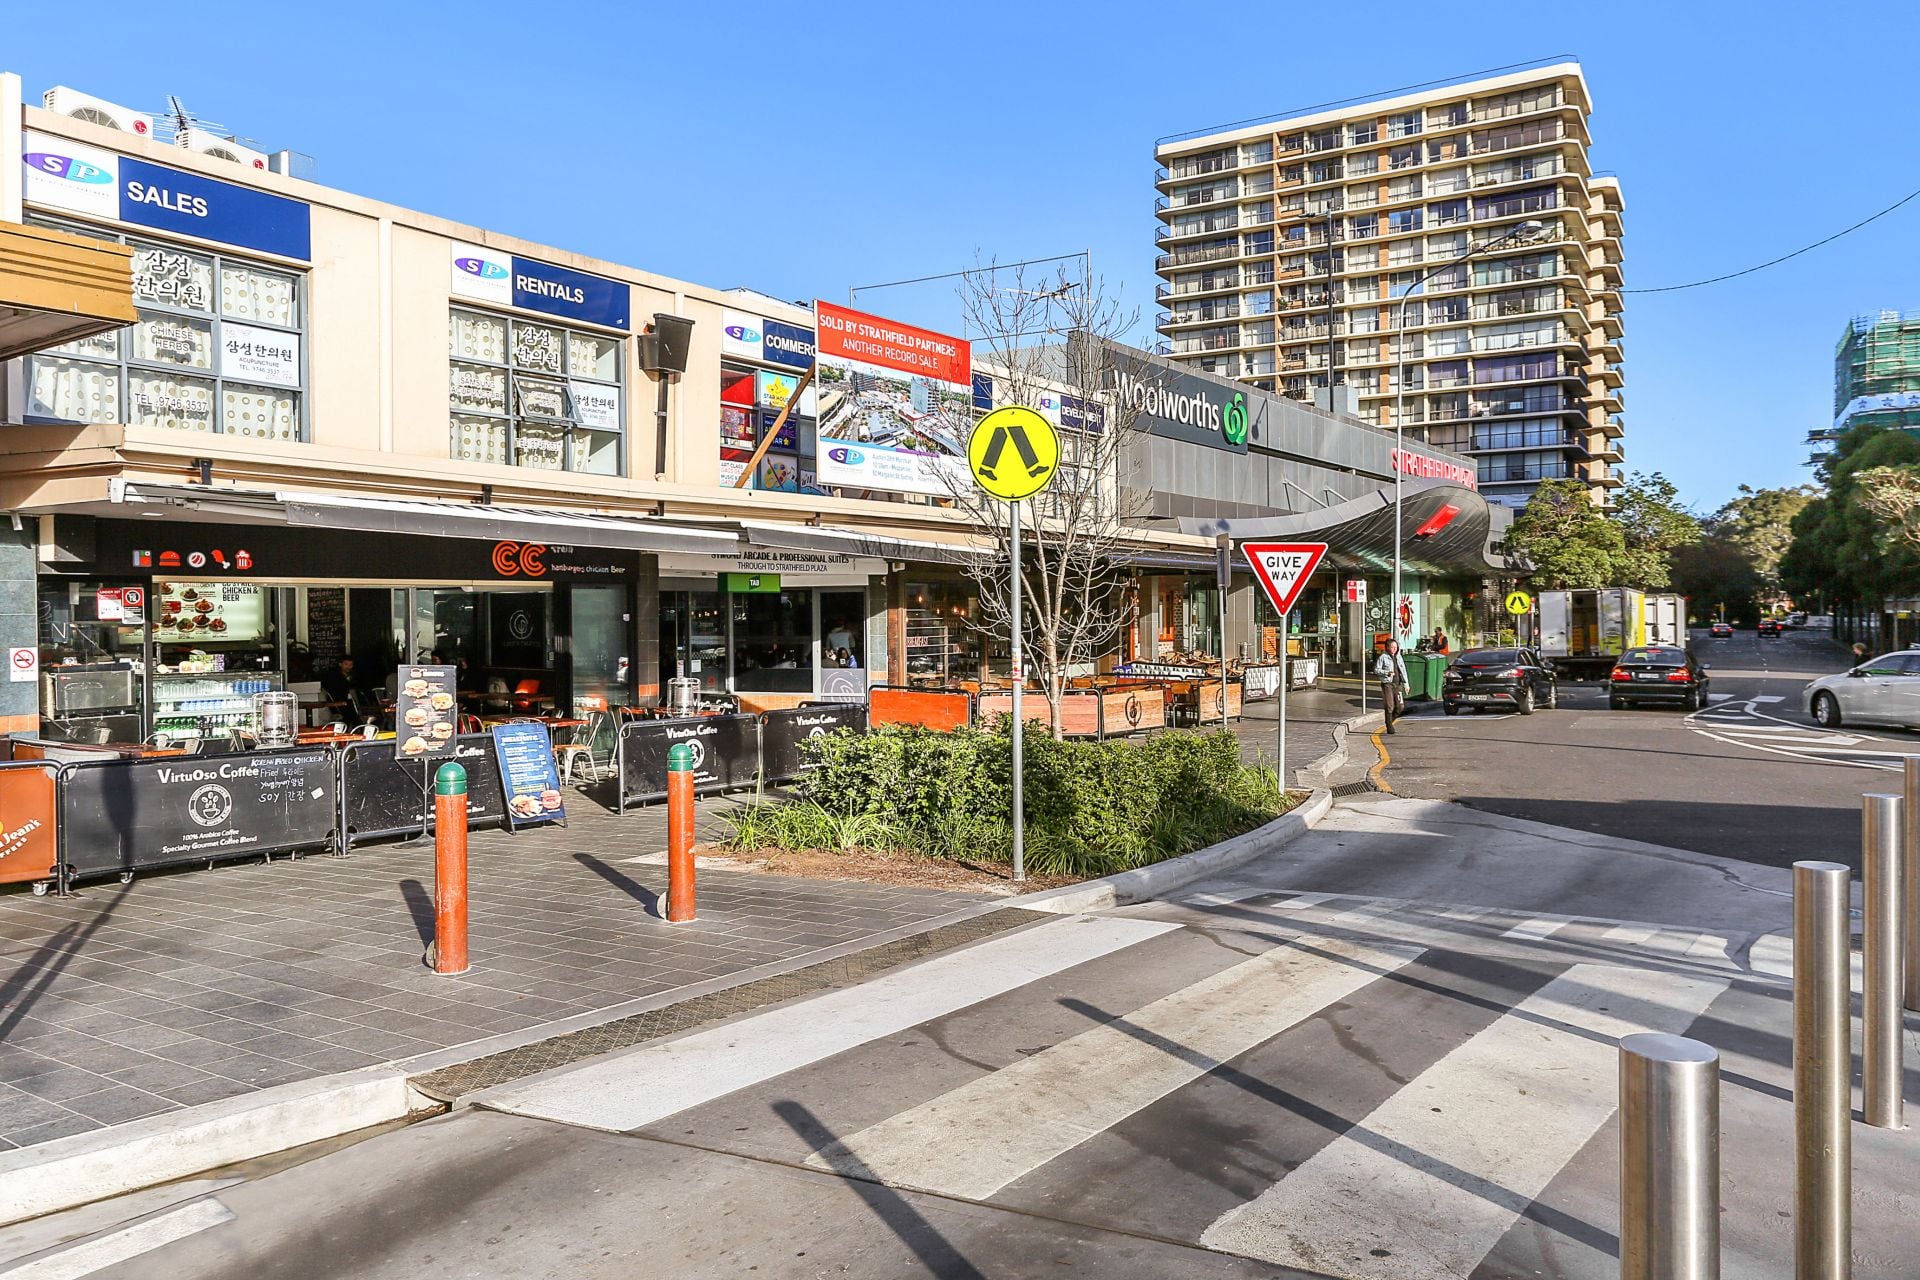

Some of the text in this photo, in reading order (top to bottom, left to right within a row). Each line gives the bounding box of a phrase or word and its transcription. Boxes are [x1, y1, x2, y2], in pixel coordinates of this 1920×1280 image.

[127, 181, 208, 218] SALES
[145, 250, 190, 278] 삼성
[135, 275, 205, 306] 한의원
[516, 275, 584, 304] RENTALS
[150, 325, 194, 341] CHINESE
[522, 326, 550, 347] 삼성
[819, 314, 956, 357] SOLD BY STRATHFIELD PARTNERS
[155, 338, 190, 353] HERBS
[226, 340, 293, 363] 삼성 한의원
[517, 348, 559, 369] 한의원
[842, 338, 938, 370] ANOTHER RECORD SALE
[239, 356, 280, 368] ACUPUNCTURE
[460, 377, 496, 389] SAMSUNG
[185, 399, 209, 412] 3537
[1113, 369, 1219, 432] Woolworths
[1391, 447, 1476, 492] STRATHFIELD PLAZA
[743, 551, 771, 561] ARCADE
[772, 553, 778, 561] &
[779, 553, 827, 563] PROFESSIONAL
[828, 555, 849, 564] SUITES
[1266, 556, 1302, 568] GIVE
[610, 565, 626, 574] Beer
[738, 561, 828, 572] THROUGH TO STRATHFIELD PLAZA
[750, 579, 760, 587] TAB
[1271, 571, 1297, 581] WAY
[222, 586, 252, 595] CHICKEN
[222, 594, 240, 602] BEER
[697, 724, 718, 736] Coffee
[455, 744, 485, 758] Coffee
[157, 763, 259, 784] VirtuOso Coffee
[2, 819, 42, 845] Jean's
[182, 832, 199, 841] 100%
[221, 828, 240, 838] Coffee
[162, 834, 258, 855] Specialty Gourmet Coffee Blend
